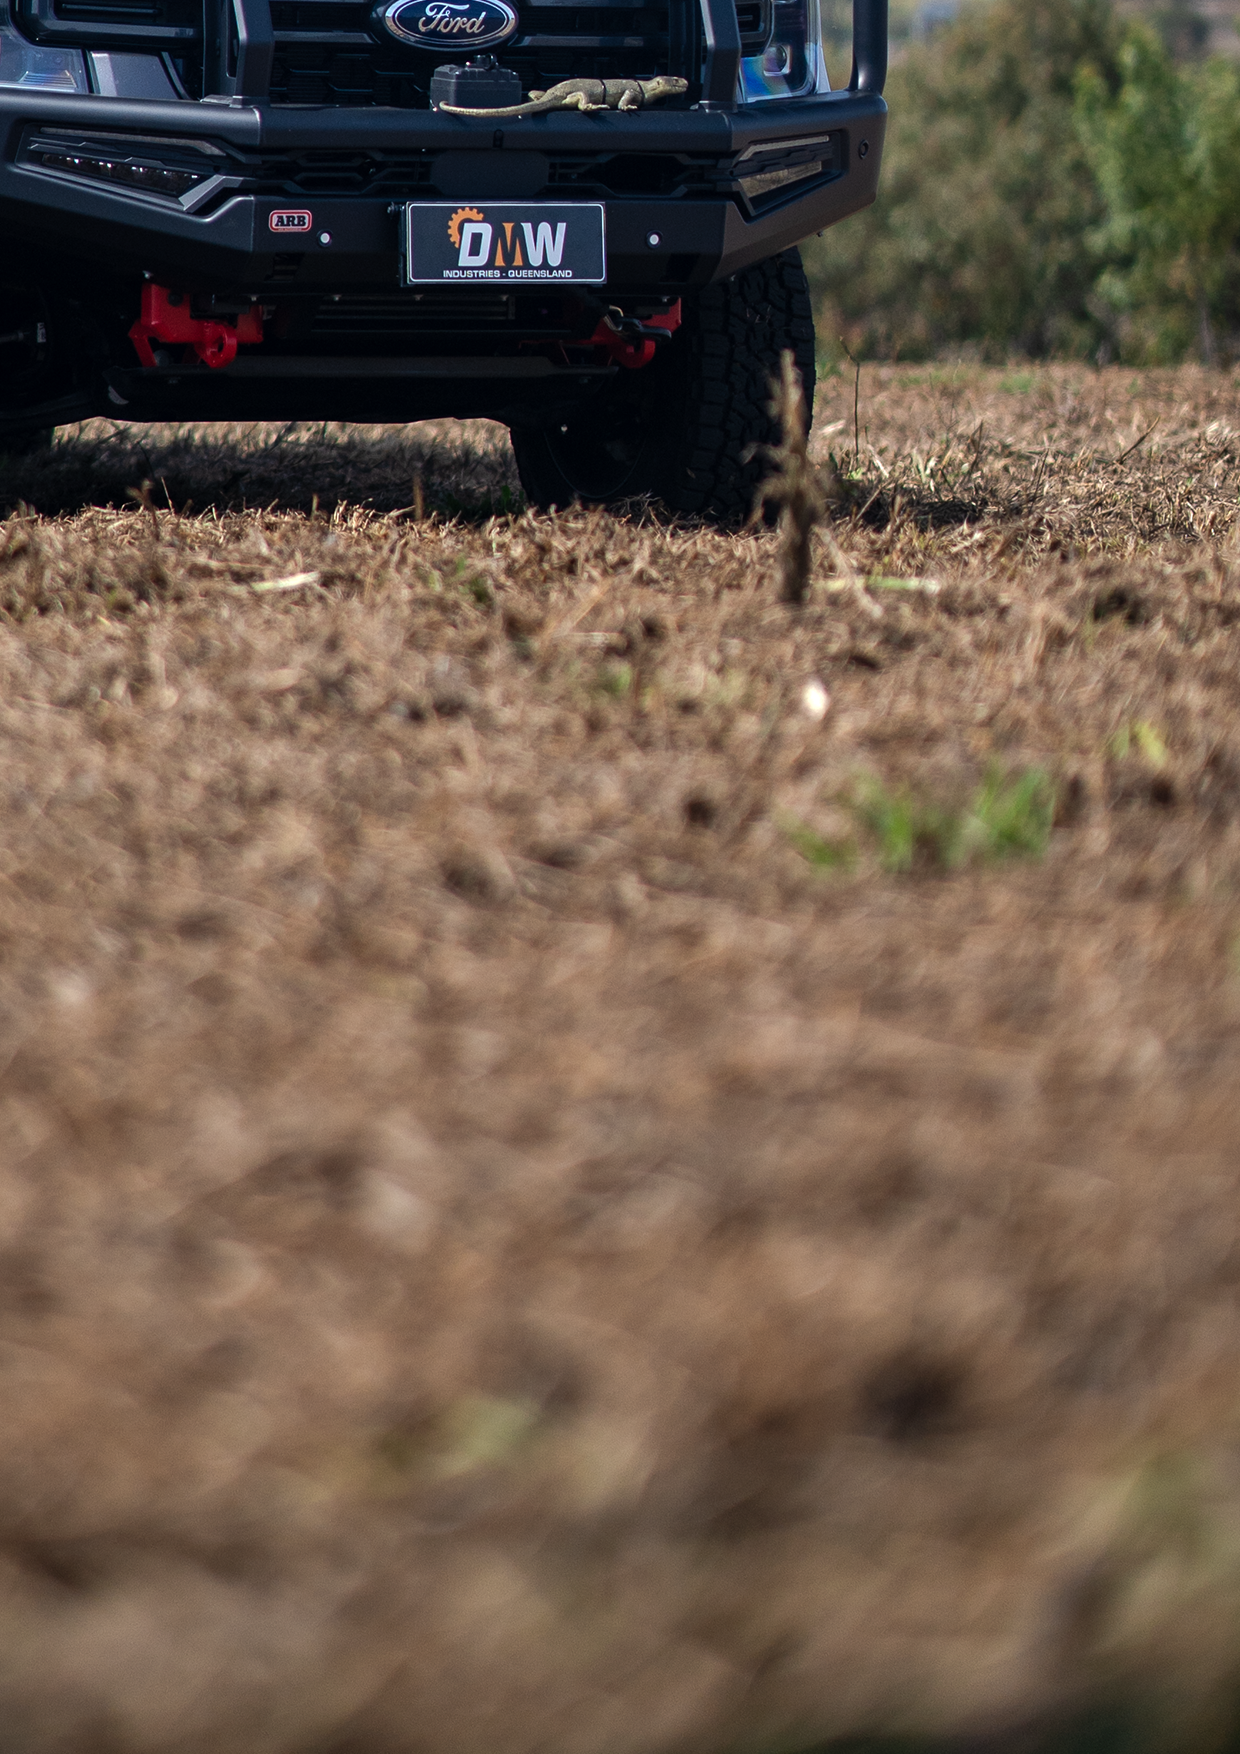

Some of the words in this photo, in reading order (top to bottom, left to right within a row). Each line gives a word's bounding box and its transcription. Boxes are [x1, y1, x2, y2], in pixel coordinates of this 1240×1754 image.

[419, 2, 487, 34] Ford
[274, 215, 307, 227] ARB
[443, 270, 501, 278] INDUSTRIES
[508, 270, 573, 279] QUEENSLAND
